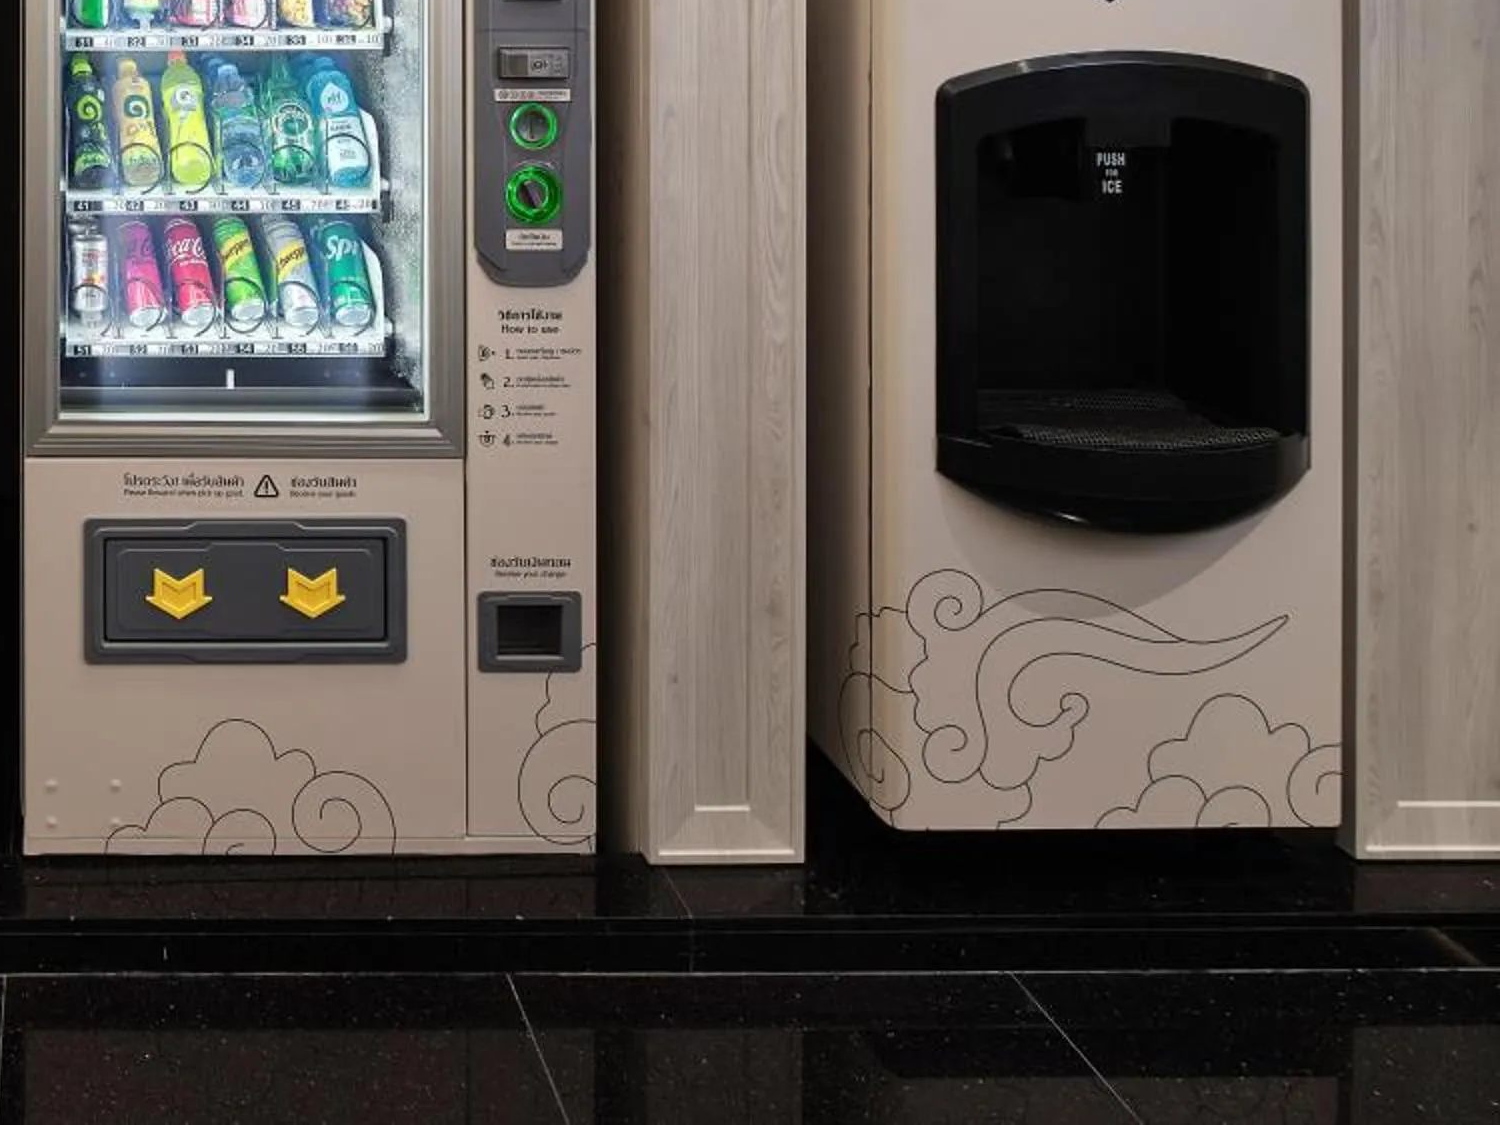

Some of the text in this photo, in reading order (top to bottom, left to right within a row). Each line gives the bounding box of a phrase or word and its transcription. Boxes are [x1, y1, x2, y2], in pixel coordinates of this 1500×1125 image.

[1097, 152, 1125, 166] PUSH
[1102, 179, 1122, 194] ICE
[501, 324, 560, 334] How to use
